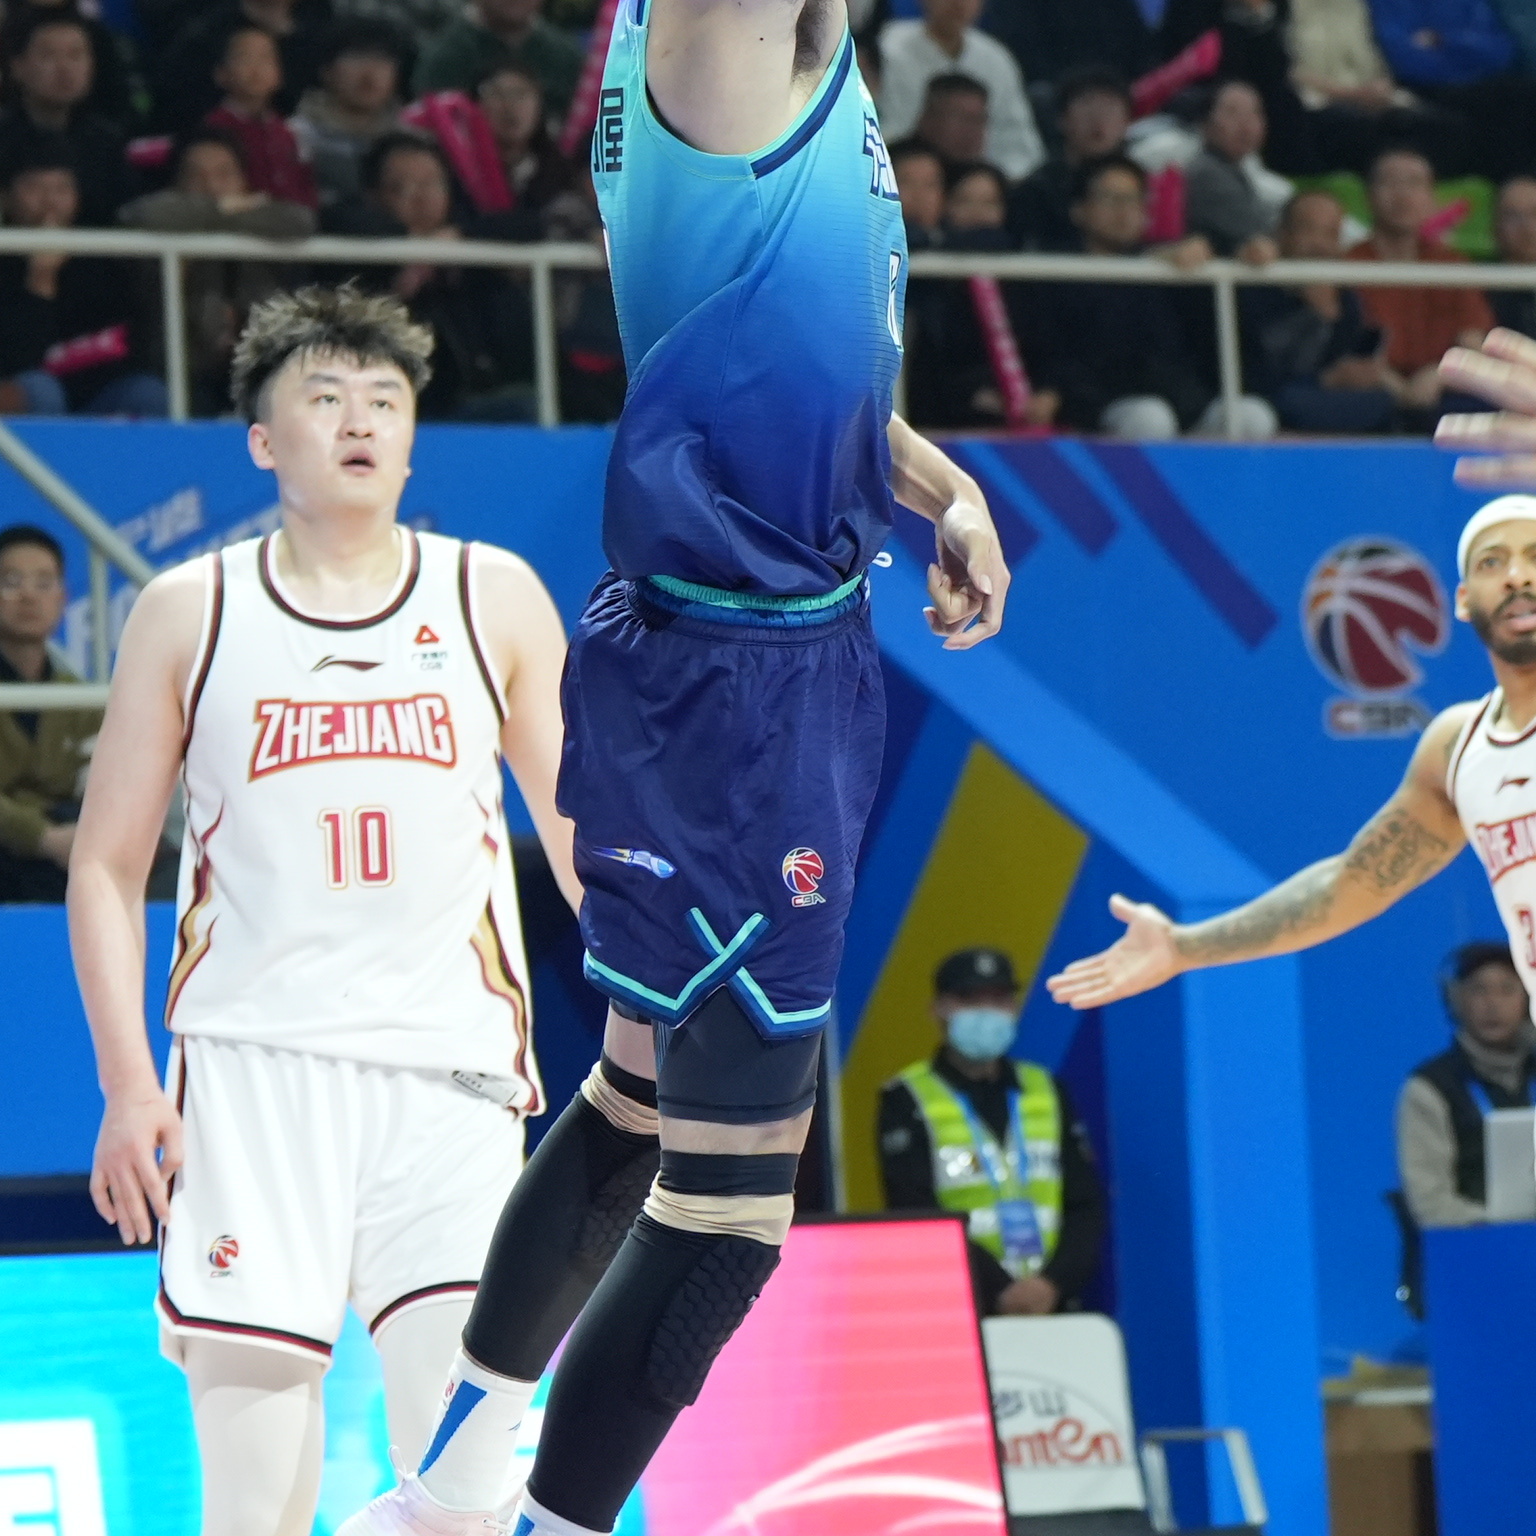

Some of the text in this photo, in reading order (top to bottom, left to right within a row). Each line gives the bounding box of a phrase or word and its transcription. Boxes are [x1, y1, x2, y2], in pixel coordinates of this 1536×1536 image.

[251, 695, 456, 776] ZHEJIANG
[319, 807, 394, 889] 10
[792, 893, 826, 907] CBA
